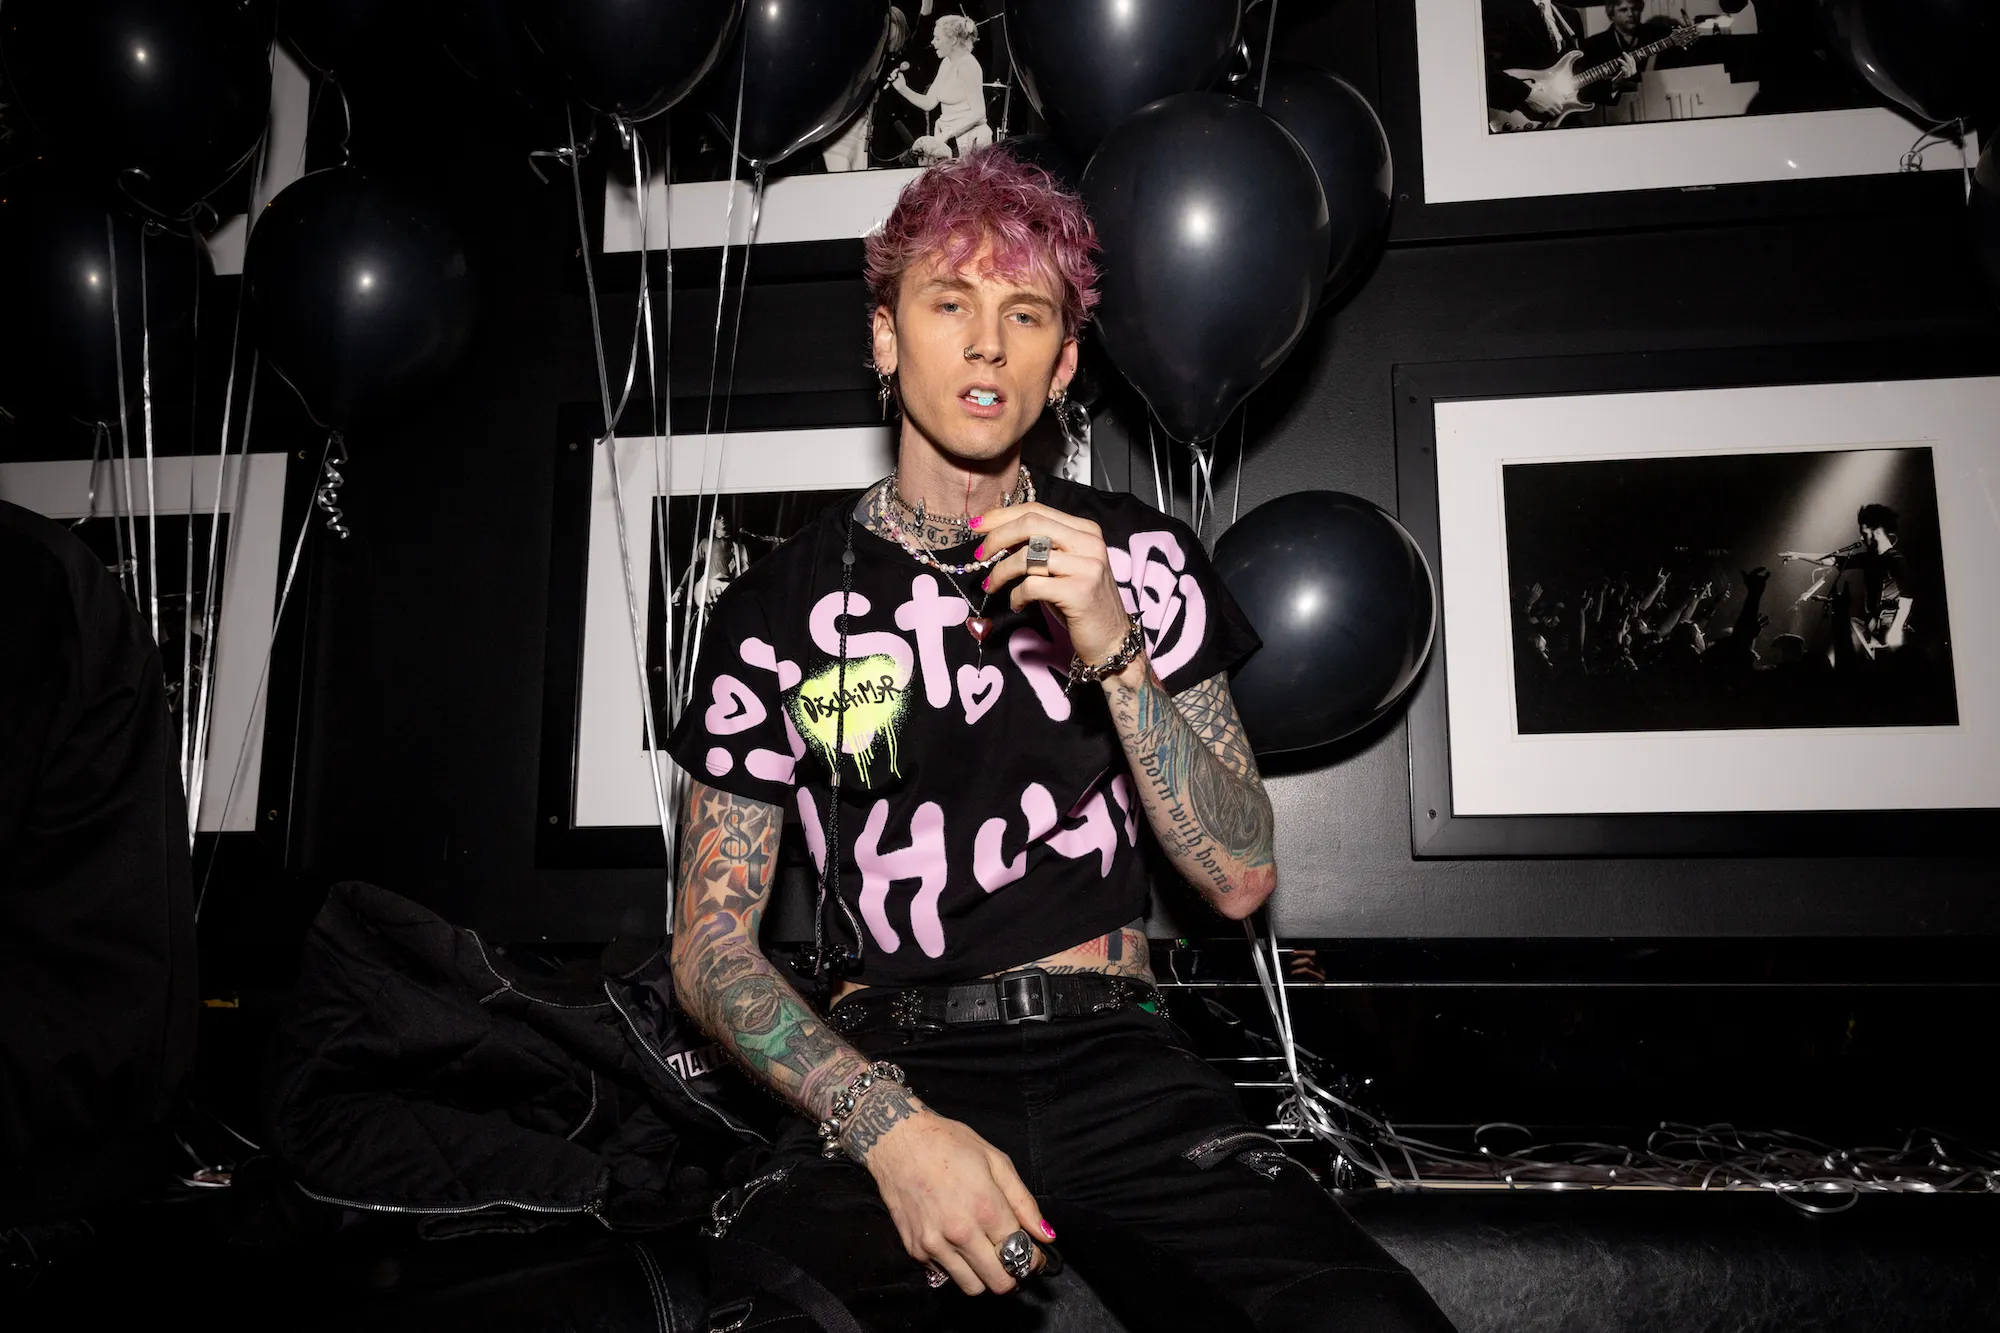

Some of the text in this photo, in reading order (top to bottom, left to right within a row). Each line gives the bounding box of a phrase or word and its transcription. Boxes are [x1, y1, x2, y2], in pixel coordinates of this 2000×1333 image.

[1139, 750, 1174, 801] born
[1168, 803, 1207, 848] with
[1193, 845, 1234, 894] horns
